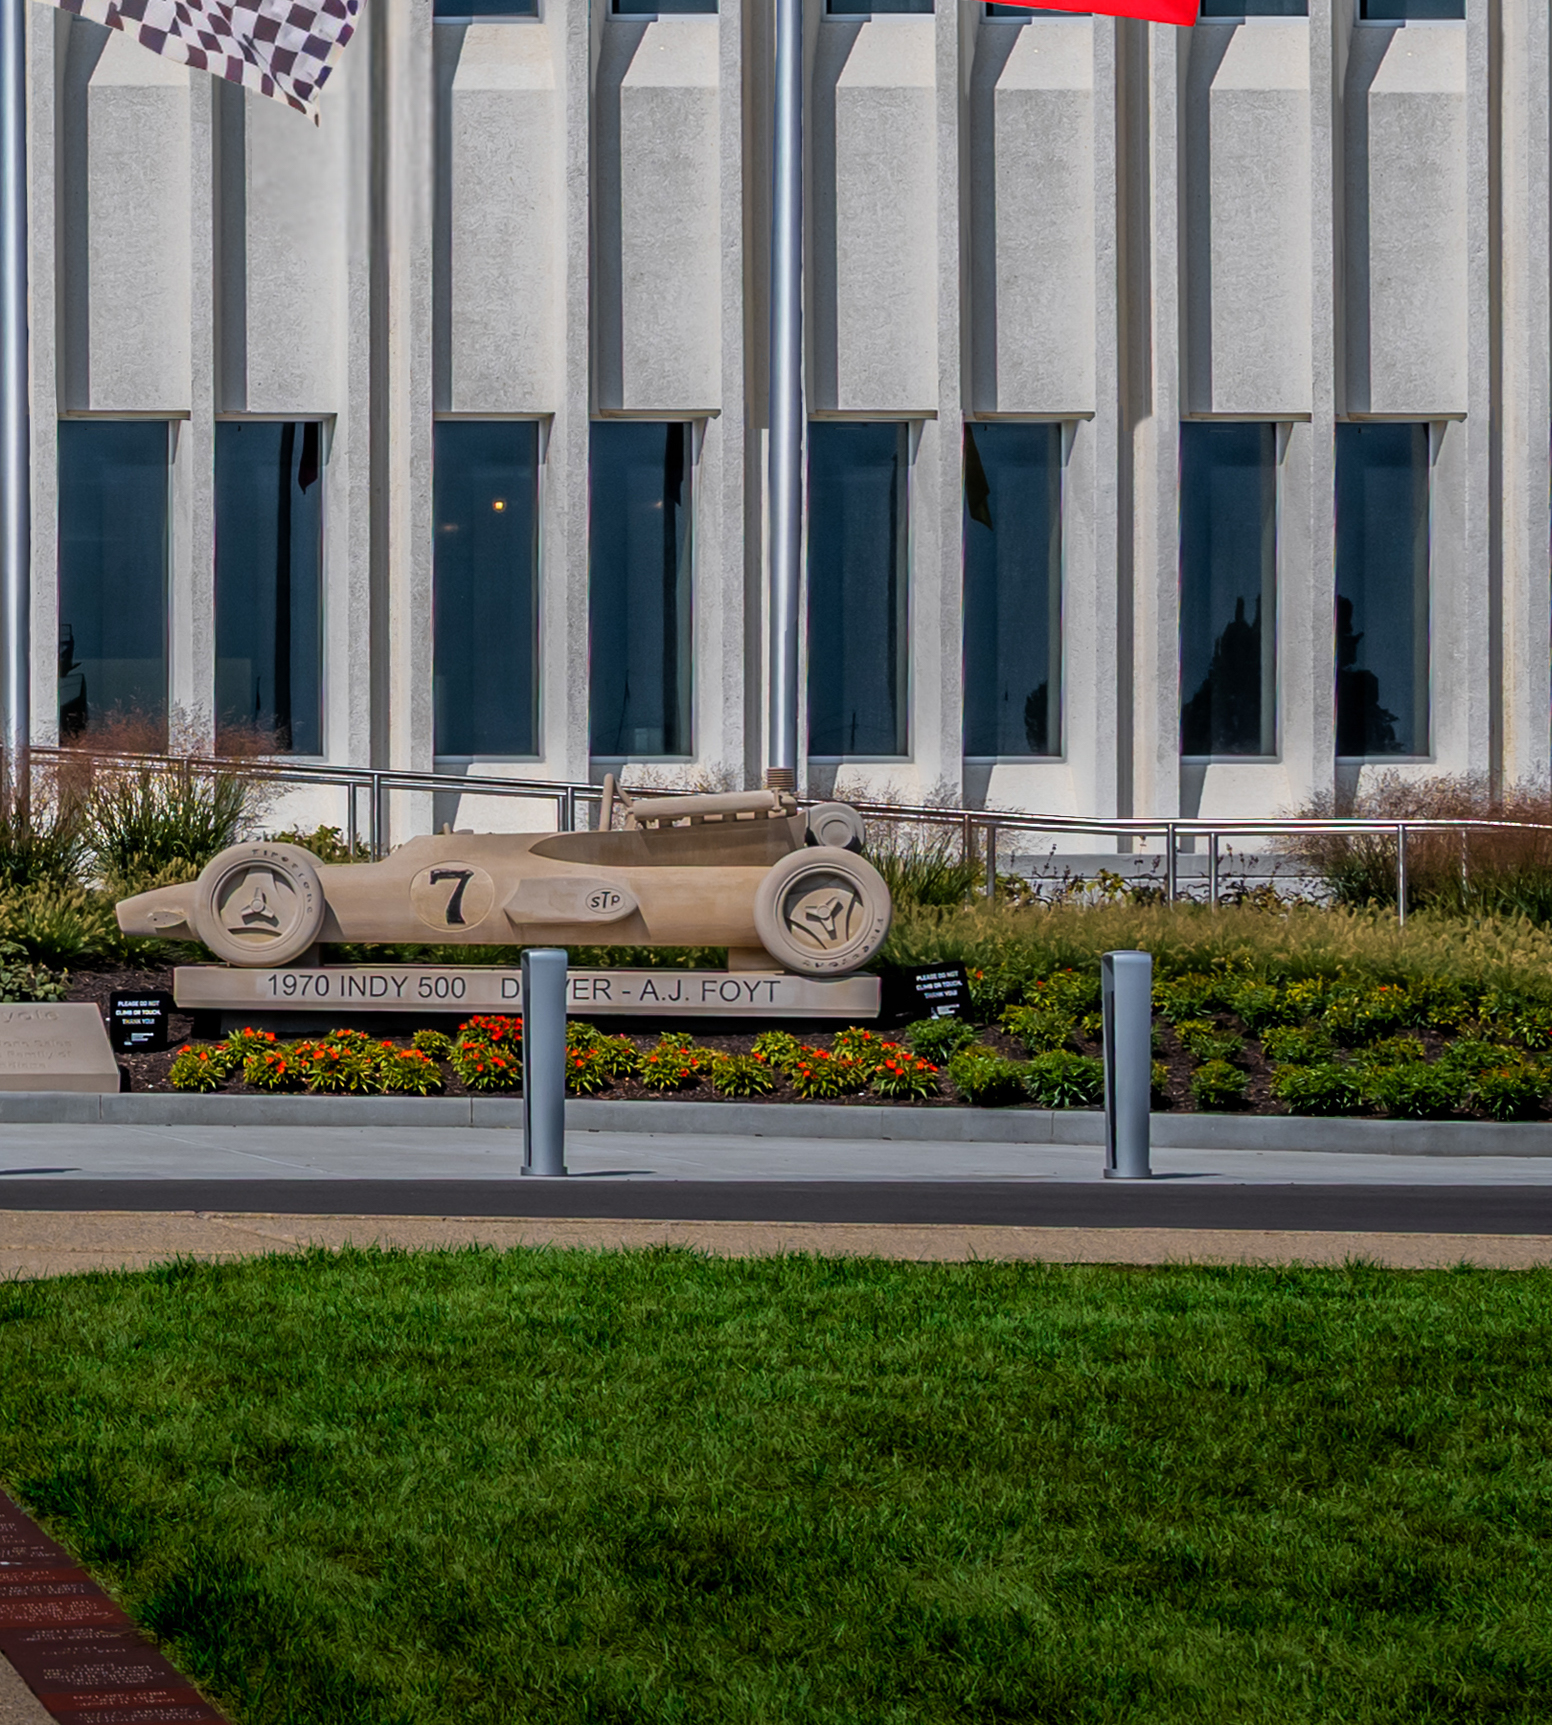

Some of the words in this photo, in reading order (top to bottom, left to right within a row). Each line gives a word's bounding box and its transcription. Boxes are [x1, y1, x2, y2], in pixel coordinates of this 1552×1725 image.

[429, 868, 475, 926] 7
[590, 891, 621, 909] STP
[916, 973, 938, 982] PLEASE
[946, 970, 959, 978] NOT
[268, 974, 330, 997] 1970
[340, 975, 409, 998] INDY
[417, 976, 467, 1000] 500
[640, 978, 690, 1003] A.J.
[701, 980, 782, 1004] FOYT
[915, 983, 933, 991] CLIMB
[924, 991, 944, 999] THANK
